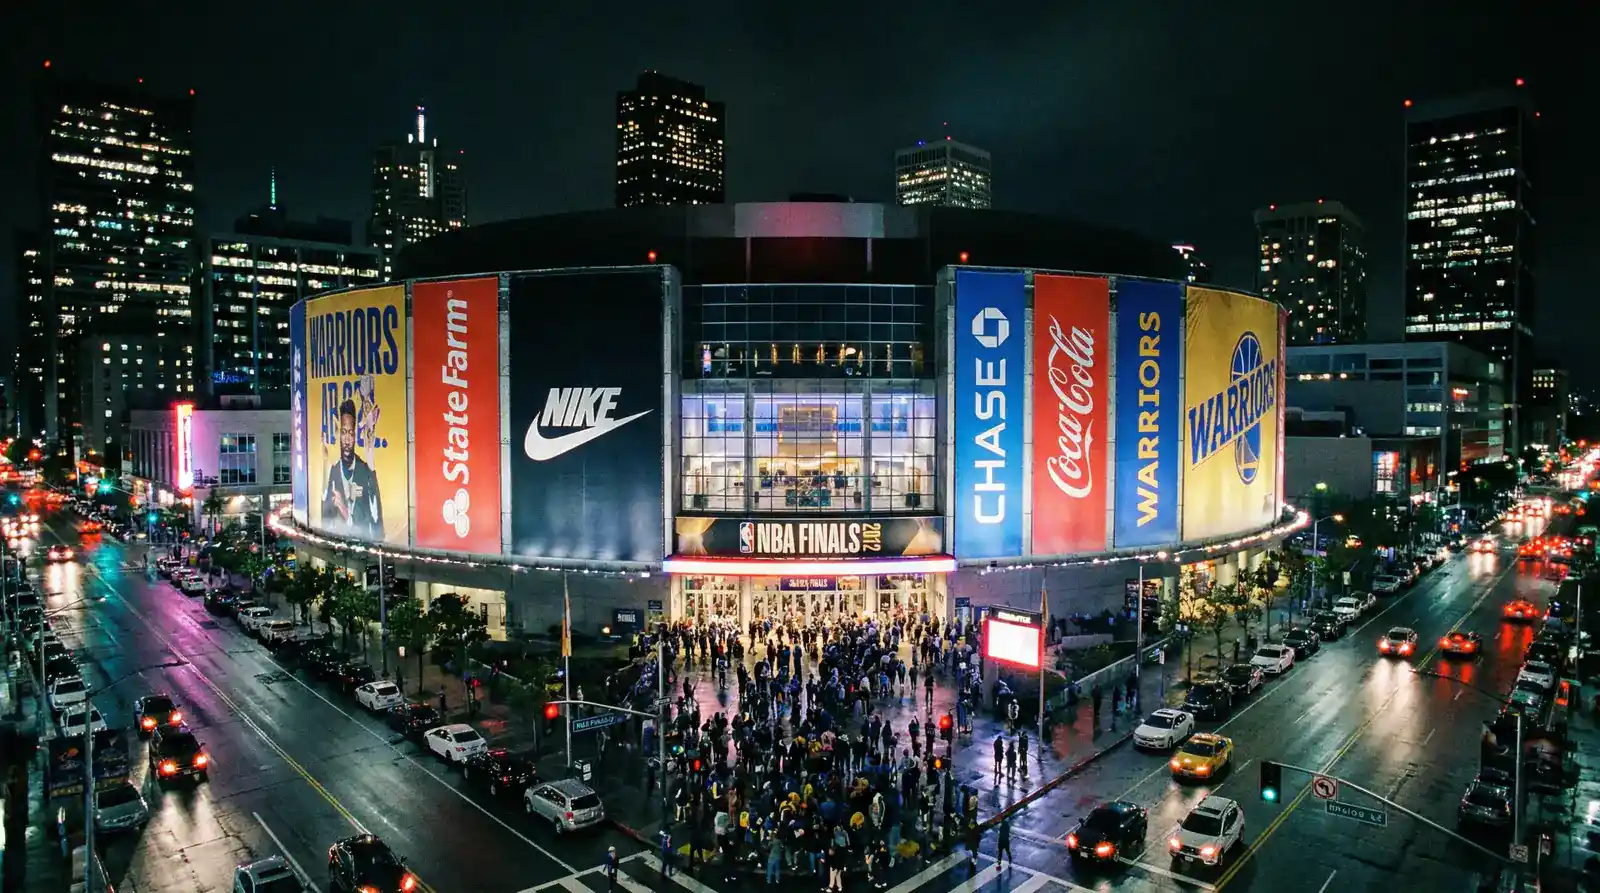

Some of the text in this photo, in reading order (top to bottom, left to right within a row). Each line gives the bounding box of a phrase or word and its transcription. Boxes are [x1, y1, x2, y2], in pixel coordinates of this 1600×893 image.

[309, 305, 398, 378] WARRIORS
[541, 387, 622, 427] NIKE
[974, 357, 1006, 524] CHASE
[1047, 314, 1095, 498] Coca-Cola
[1137, 311, 1161, 527] WARRIORS
[1188, 358, 1276, 465] WARRIORS
[757, 522, 860, 554] NBA FINALS
[862, 522, 882, 552] 2012
